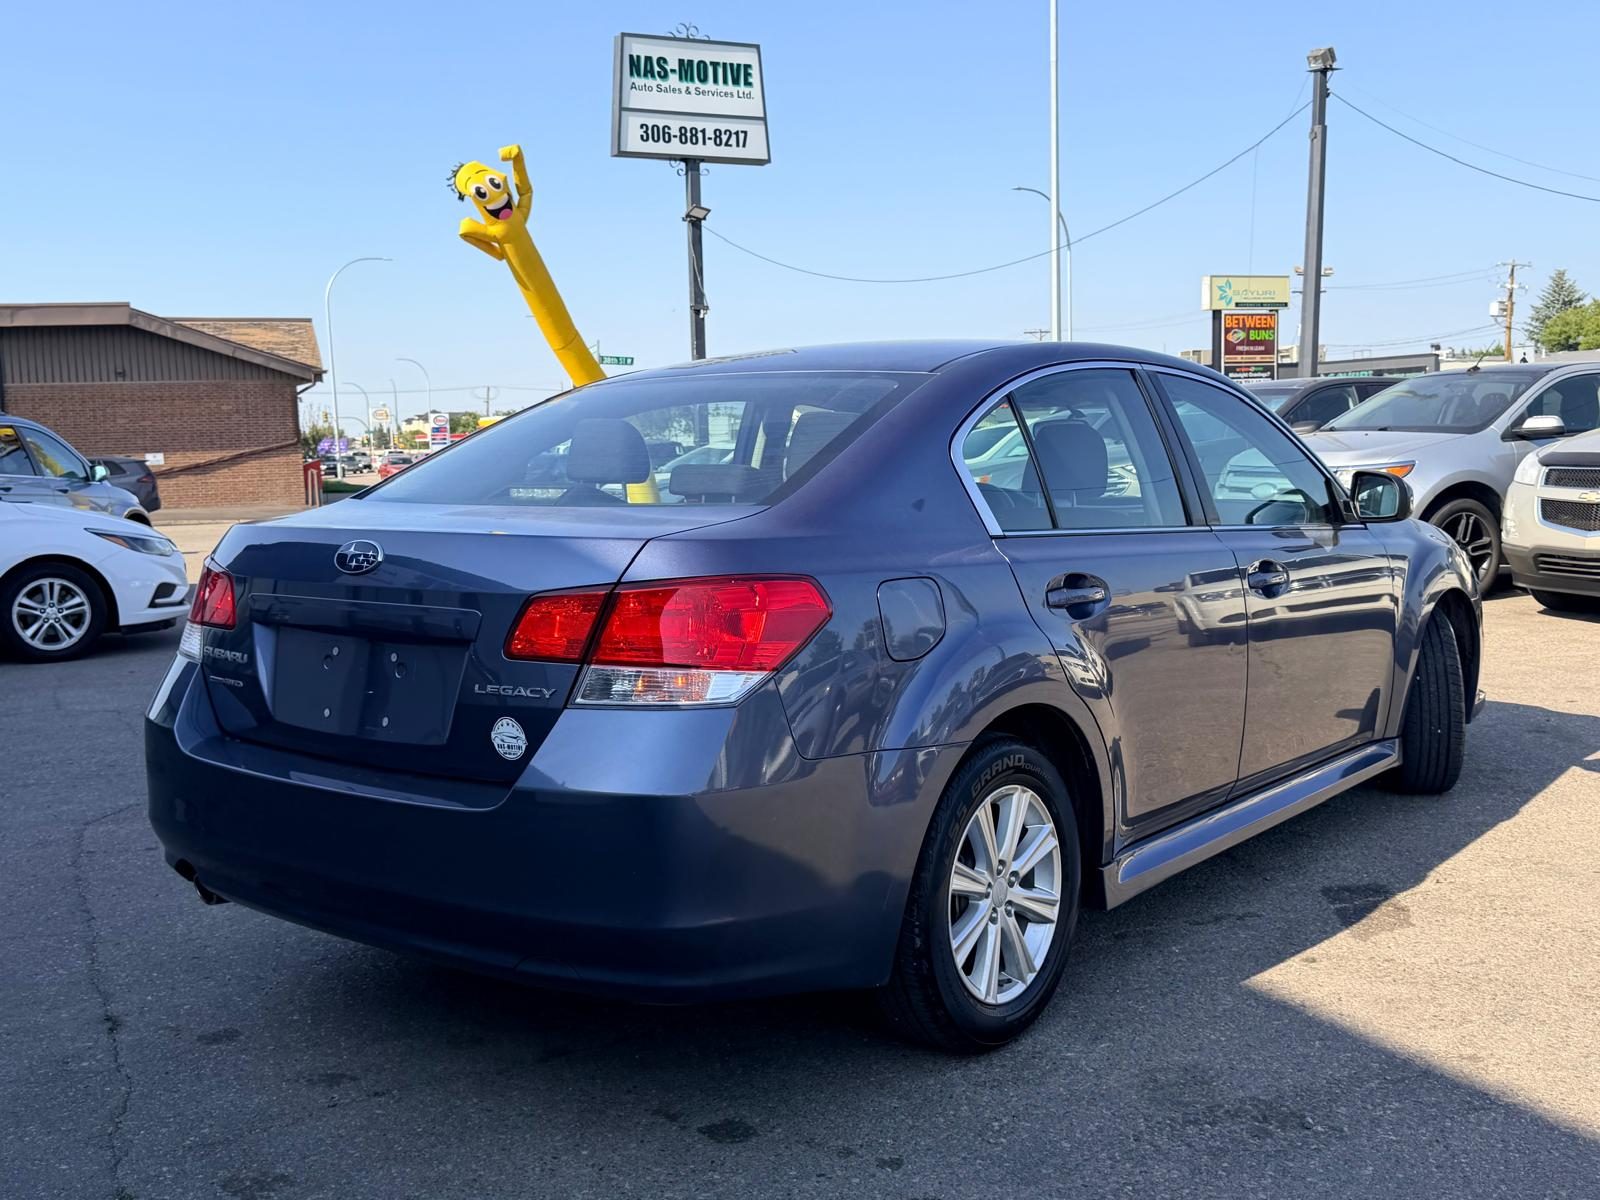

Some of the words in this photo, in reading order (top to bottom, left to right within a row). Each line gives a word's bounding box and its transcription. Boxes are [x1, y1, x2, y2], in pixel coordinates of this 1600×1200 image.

[628, 54, 753, 88] NAS-MOTIVE
[630, 82, 653, 93] Auto
[656, 84, 682, 95] Sales
[685, 86, 691, 95] &
[695, 87, 734, 98] Services
[736, 90, 754, 100] Ltd.
[640, 123, 748, 148] 306-881-8217
[1225, 315, 1275, 328] BETWEEN
[1249, 330, 1274, 340] BUNS
[203, 645, 248, 664] SUBARU
[474, 684, 557, 699] LEGACY
[971, 754, 1024, 797] GRAND
